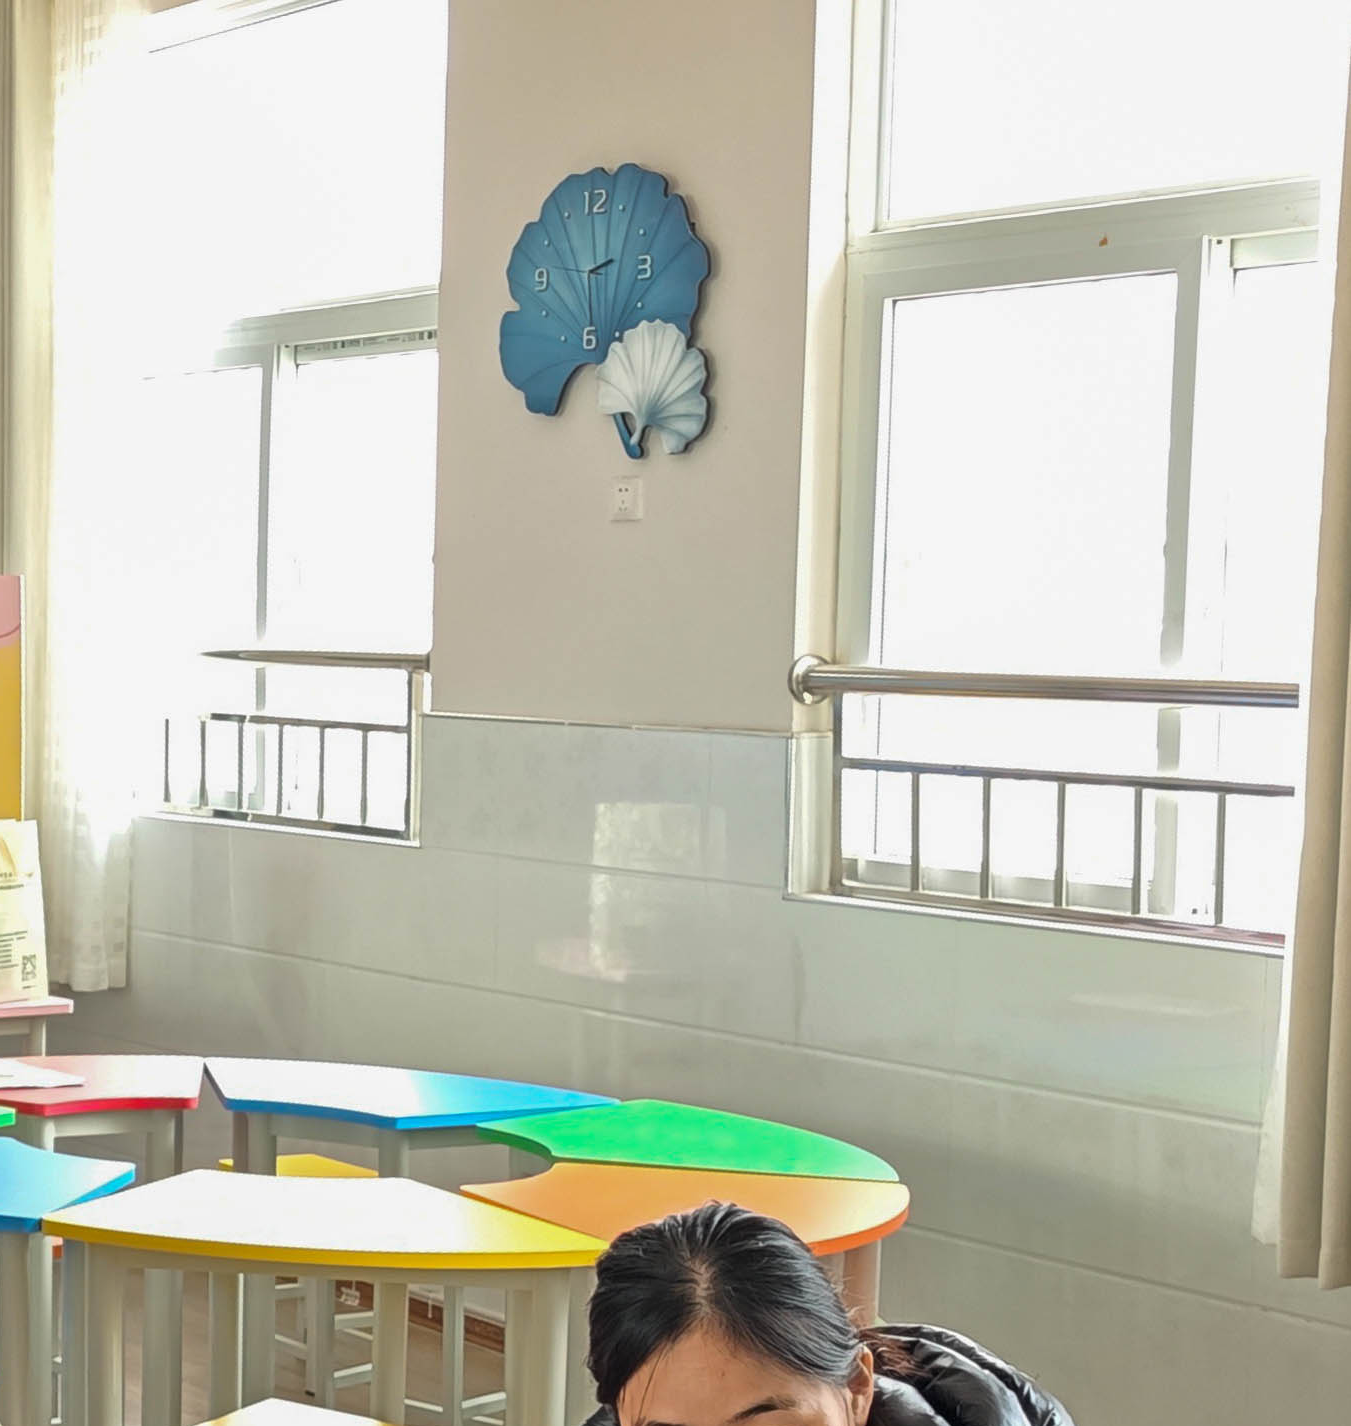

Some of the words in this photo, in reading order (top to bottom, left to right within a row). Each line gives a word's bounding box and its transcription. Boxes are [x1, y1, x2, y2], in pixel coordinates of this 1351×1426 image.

[584, 189, 608, 215] 12
[533, 267, 549, 291] 9
[636, 255, 653, 280] 3
[581, 326, 597, 350] 6
